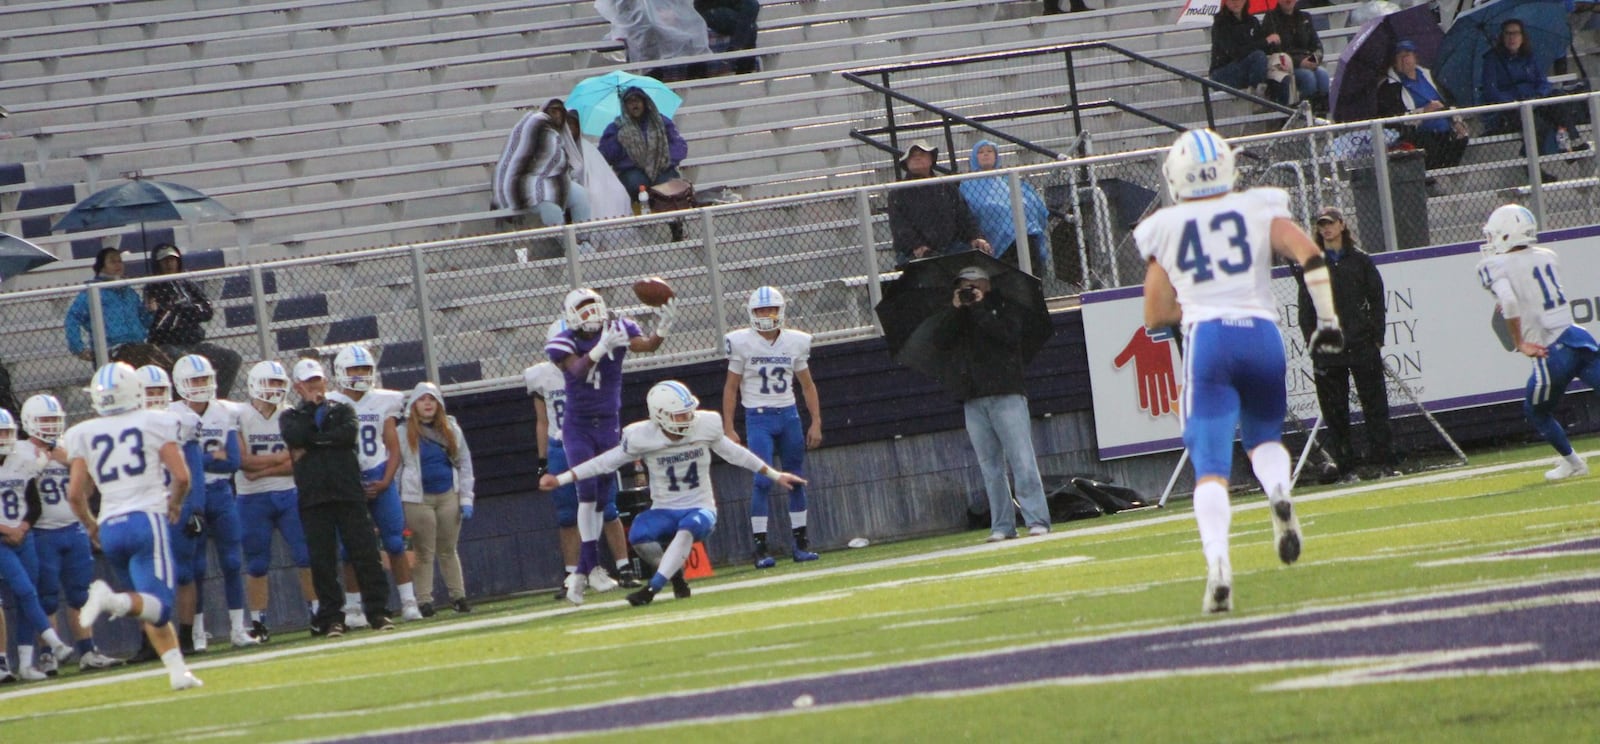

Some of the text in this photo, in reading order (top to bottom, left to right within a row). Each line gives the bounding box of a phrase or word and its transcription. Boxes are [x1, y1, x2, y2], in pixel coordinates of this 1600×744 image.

[1176, 210, 1252, 284] 43
[1532, 263, 1567, 311] 11
[586, 361, 602, 390] 4
[758, 366, 788, 395] 13
[91, 426, 147, 485] 23
[655, 447, 704, 467] SPRINGBORO
[665, 461, 700, 492] 14
